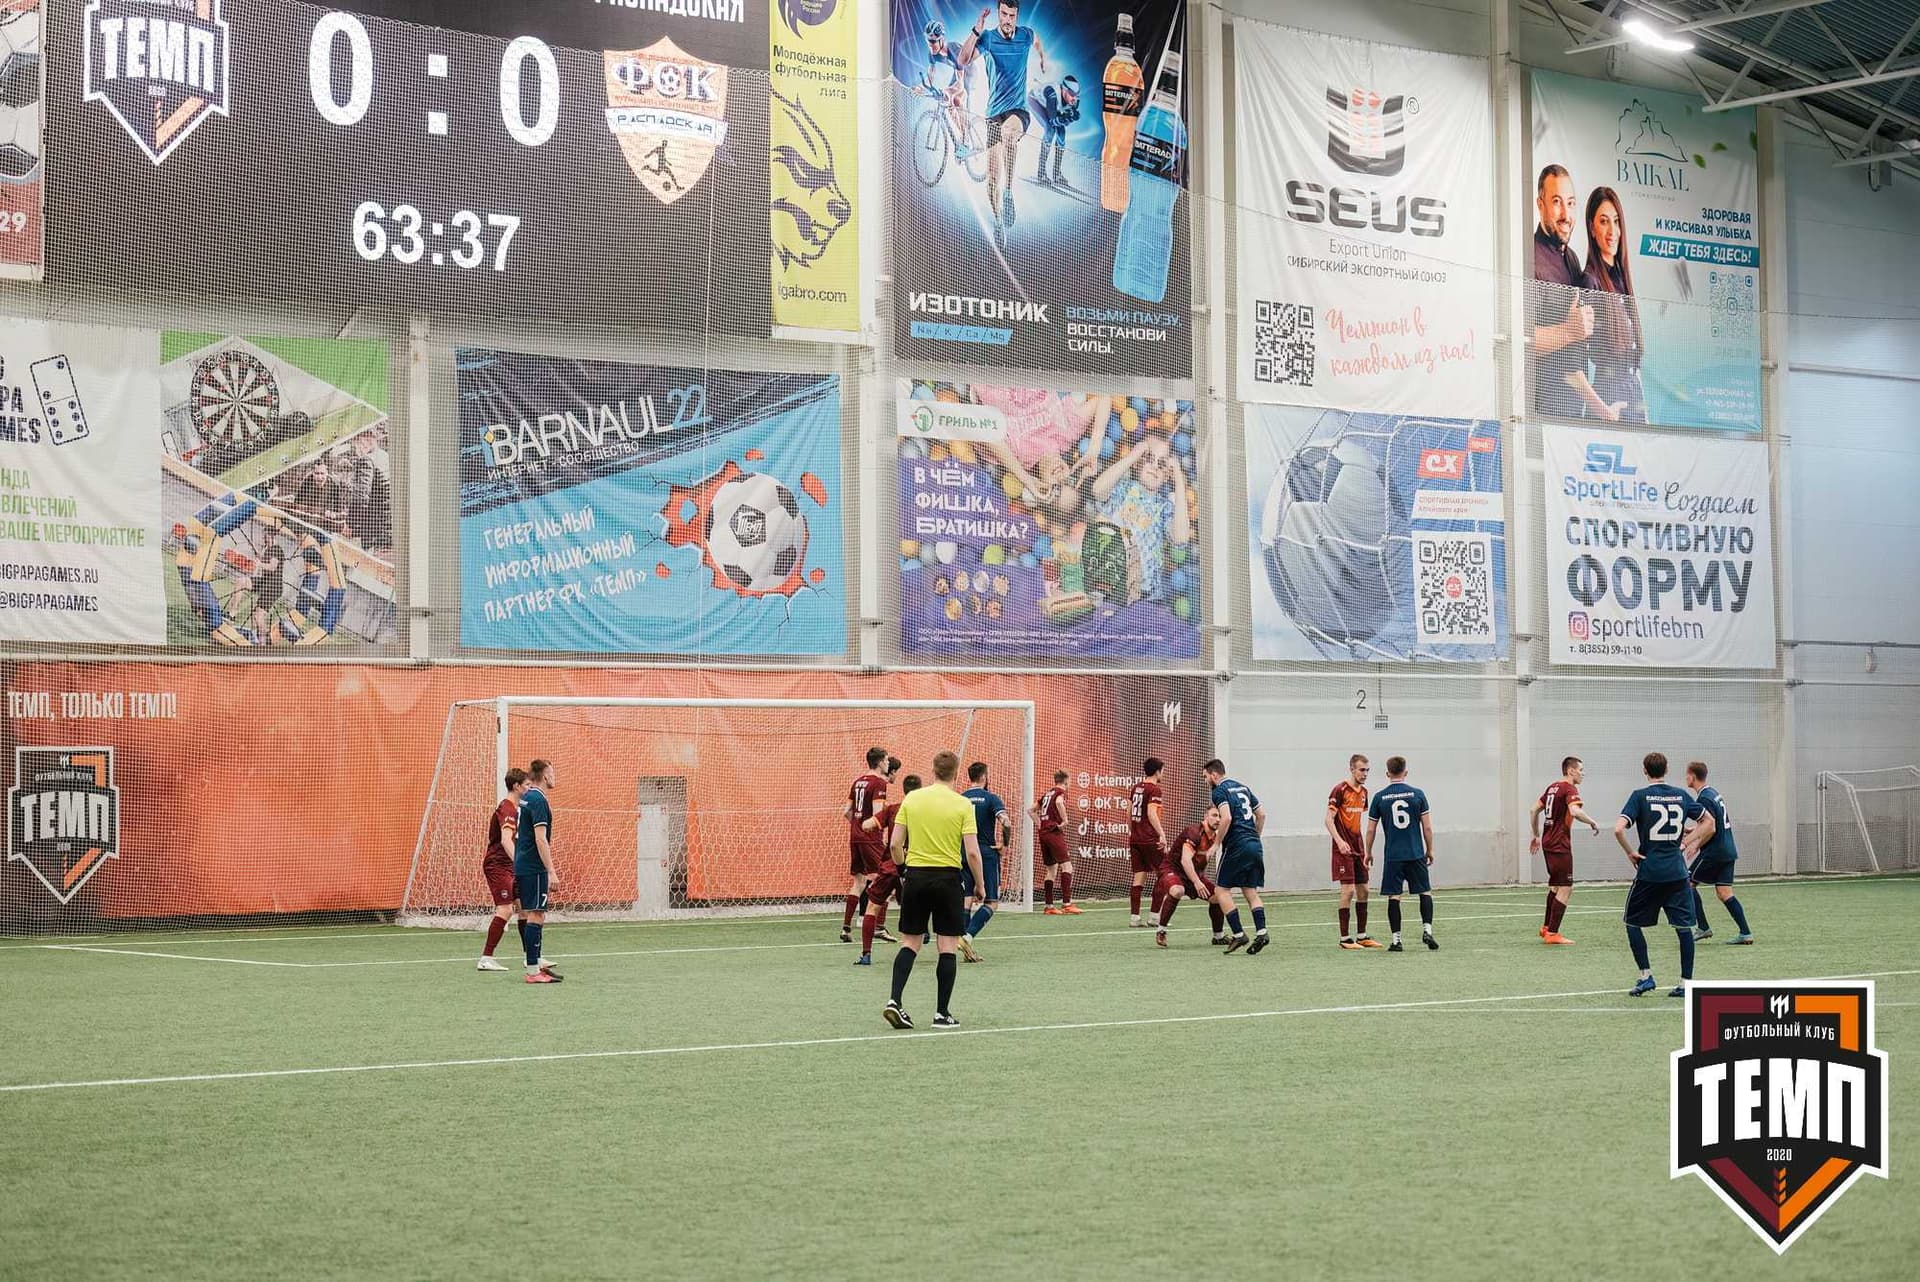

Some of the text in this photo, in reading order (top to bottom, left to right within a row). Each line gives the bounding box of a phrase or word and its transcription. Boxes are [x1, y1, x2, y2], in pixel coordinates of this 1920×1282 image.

[100, 17, 214, 93] ТЕМП
[773, 45, 847, 68] Молодёжная
[309, 12, 373, 125] 0
[500, 35, 559, 146] 0
[775, 62, 847, 83] футбольная
[819, 88, 847, 99] лига
[1617, 159, 1690, 192] BAIKAL
[1285, 180, 1446, 237] SEUS
[1702, 207, 1751, 224] ЗДОРОВАЯ
[353, 201, 520, 271] 63:37
[1655, 219, 1752, 241] И КРАСИВАЯ УЛЫБКА
[1329, 238, 1407, 261] Export Union
[1648, 240, 1752, 264] ЖДЕТ ТЕБЯ ЗДЕСЬ!
[1287, 255, 1447, 283] СИБИРСКИЙ ЭКСПОРТНЫЙ СОЮЗ
[909, 292, 1050, 323] ИЗОТОНИК
[1065, 307, 1129, 322] ВОЗЬМИ
[1067, 323, 1167, 341] ВОССТАНОВИ
[939, 415, 977, 429] ГРИЛЬ
[487, 459, 548, 480] ИНТЕРНЕТ
[559, 441, 639, 467] СООБЩЕСТВО
[1583, 443, 1637, 475] SL
[1, 468, 30, 490] НДА
[914, 461, 975, 488] В ЧЁМ
[1563, 476, 1658, 502] SportLife
[1664, 481, 1759, 522] Создаем
[2, 495, 77, 518] ВЛЕЧЕНИЙ
[915, 492, 999, 516] ФИШКА,
[0, 521, 145, 547] ВАШЕ МЕРОПРИЯТИЕ
[483, 504, 595, 551] ГЕНЕРАЛЬНЫЙ
[916, 517, 1028, 539] БРАТИШКА?
[1565, 516, 1754, 554] СПОРТИВНУЮ
[484, 532, 636, 588] ИНФОРМАЦИОННЫЙ
[483, 570, 647, 623] ПАРТНЕР ФК «ТЕМП»
[1566, 554, 1753, 613] ФОРМУ
[0, 591, 99, 612] @BIGPAPAGAMES
[1591, 614, 1704, 642] sportlifebrn
[7, 691, 176, 721] ТЕМП, ТОЛЬКО ТЕМП!
[1356, 689, 1366, 709] 2
[20, 790, 109, 843] ТЕМП
[1095, 797, 1111, 810] ФК
[1237, 793, 1253, 820] 3
[1392, 800, 1410, 829] 6
[1649, 804, 1684, 841] 23
